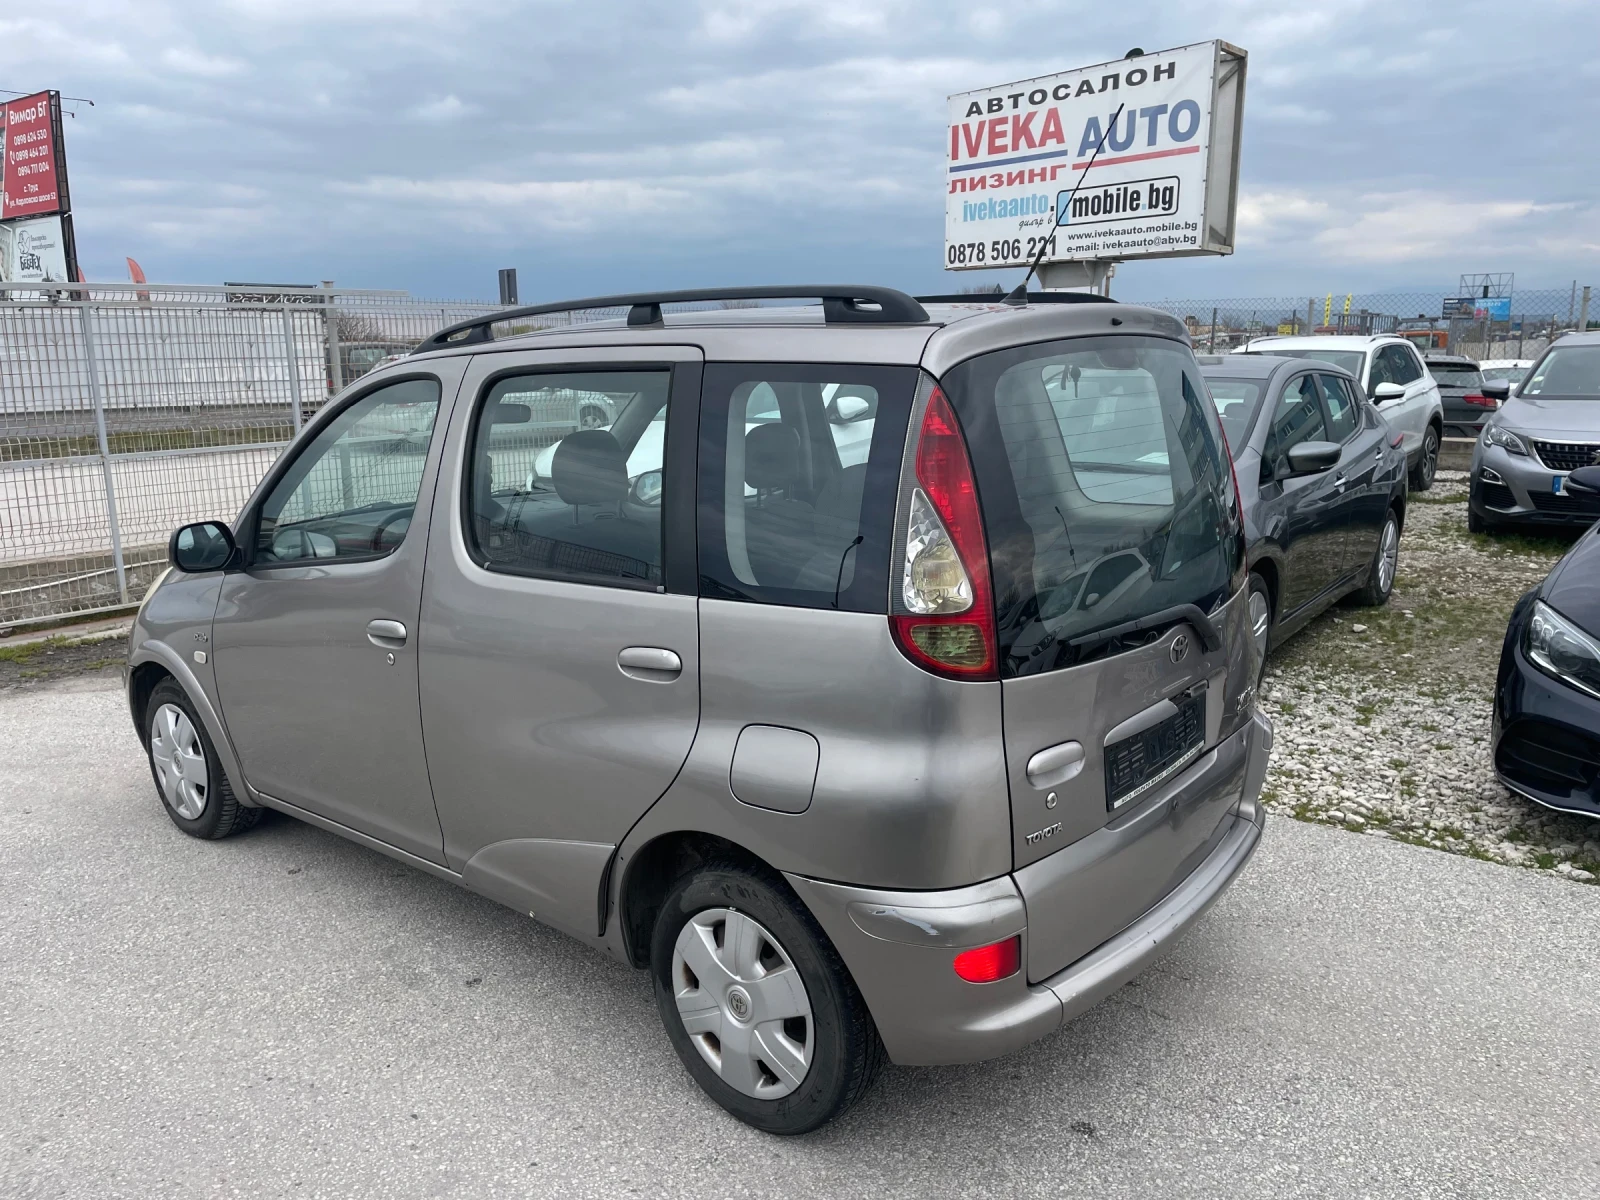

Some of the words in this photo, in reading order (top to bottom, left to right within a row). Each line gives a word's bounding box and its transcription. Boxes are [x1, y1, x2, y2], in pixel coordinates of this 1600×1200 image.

[965, 61, 1176, 118] АВТОСАЛОН
[9, 107, 36, 125] Вимар
[37, 100, 47, 118] БГ
[951, 107, 1066, 161] IVEKA
[1076, 99, 1201, 158] AUTO
[948, 163, 1067, 195] ЛИЗИНГ
[1072, 182, 1175, 219] mobile.bg
[1066, 242, 1100, 253] e-mail:
[1102, 234, 1197, 251] ivekaauto@abv.bg
[1067, 220, 1198, 241] www.ivekaauto.mobile.bg
[948, 241, 986, 265] 0878
[990, 238, 1021, 261] 506
[1026, 234, 1057, 259] 221
[1025, 821, 1063, 846] TOYOTA
